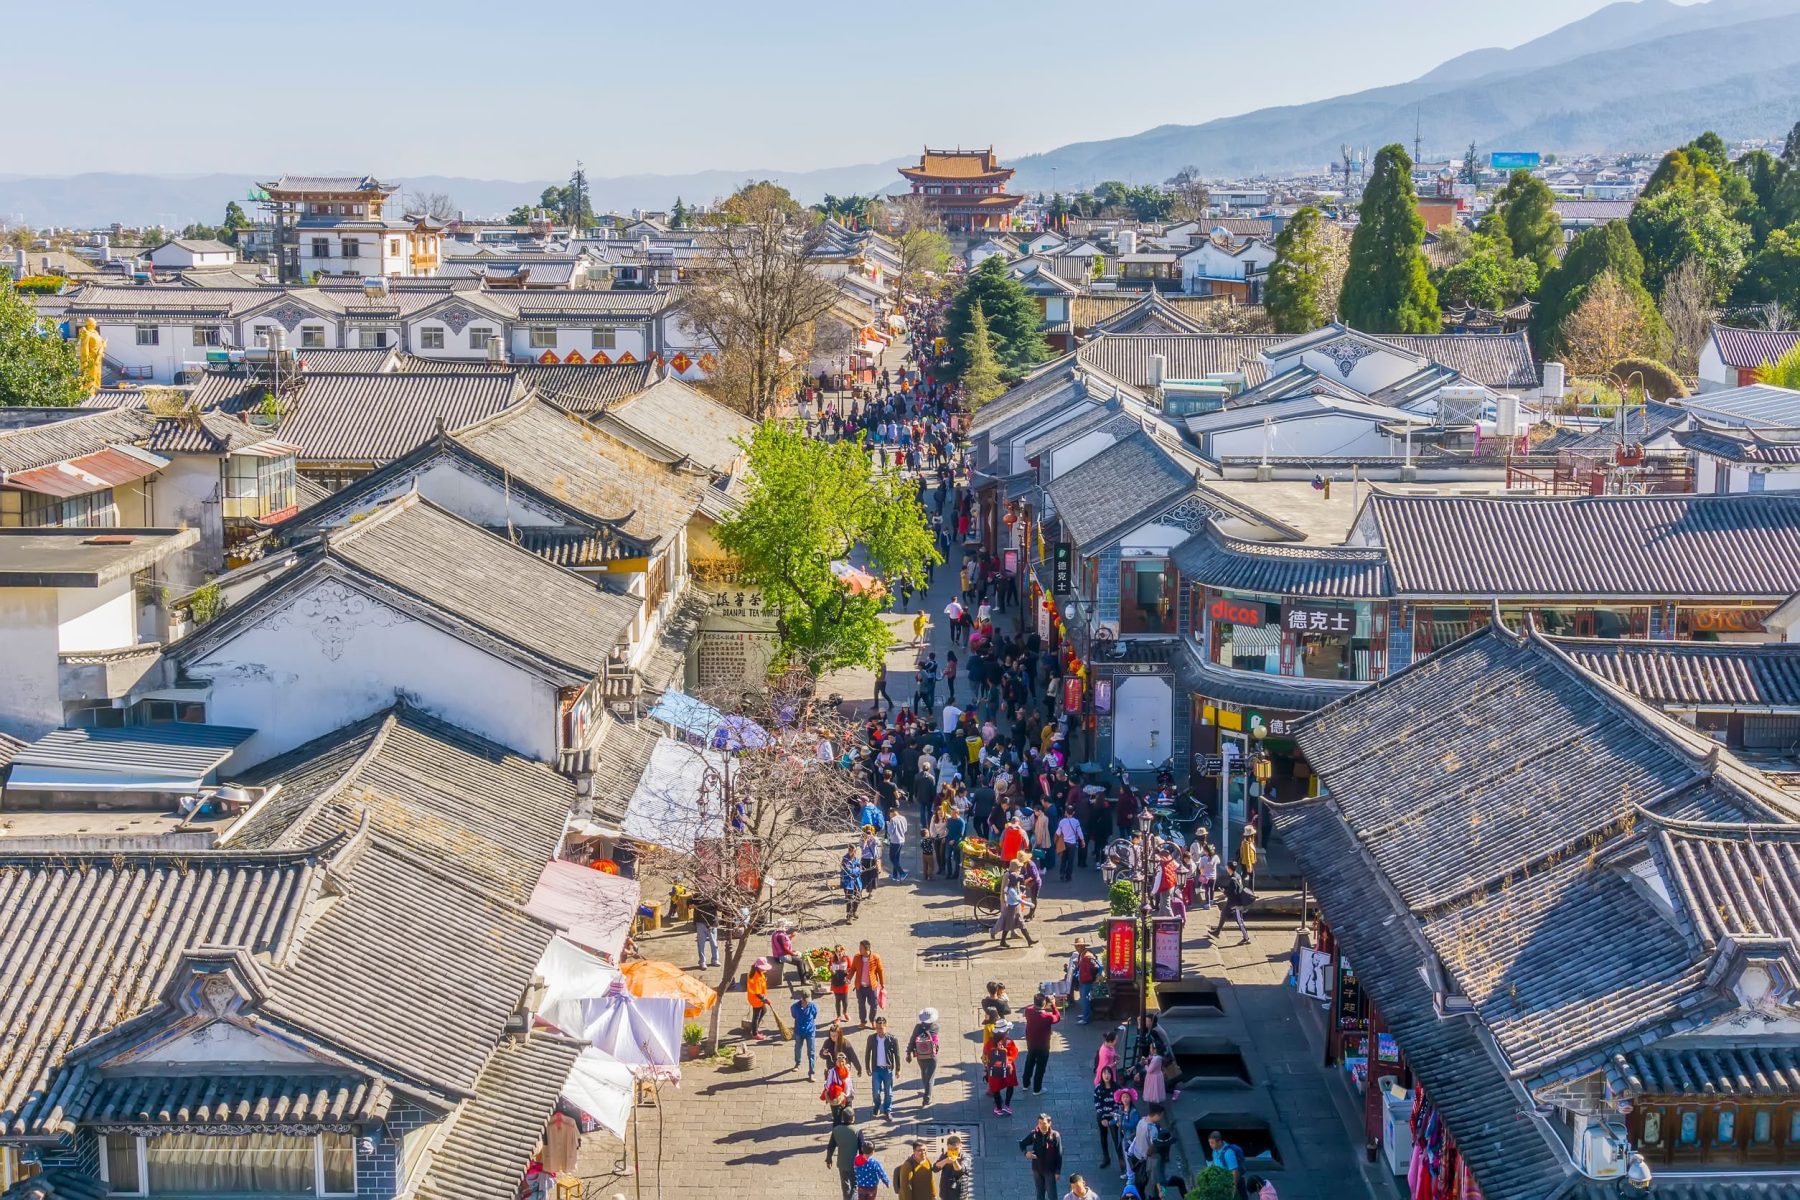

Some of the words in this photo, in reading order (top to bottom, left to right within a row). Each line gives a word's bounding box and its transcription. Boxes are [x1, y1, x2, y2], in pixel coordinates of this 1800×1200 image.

[1058, 561, 1067, 591] 德克士
[723, 609, 746, 617] DIANPU
[750, 608, 760, 617] TEA
[1210, 600, 1259, 625] dicos
[1288, 610, 1350, 631] 德克士
